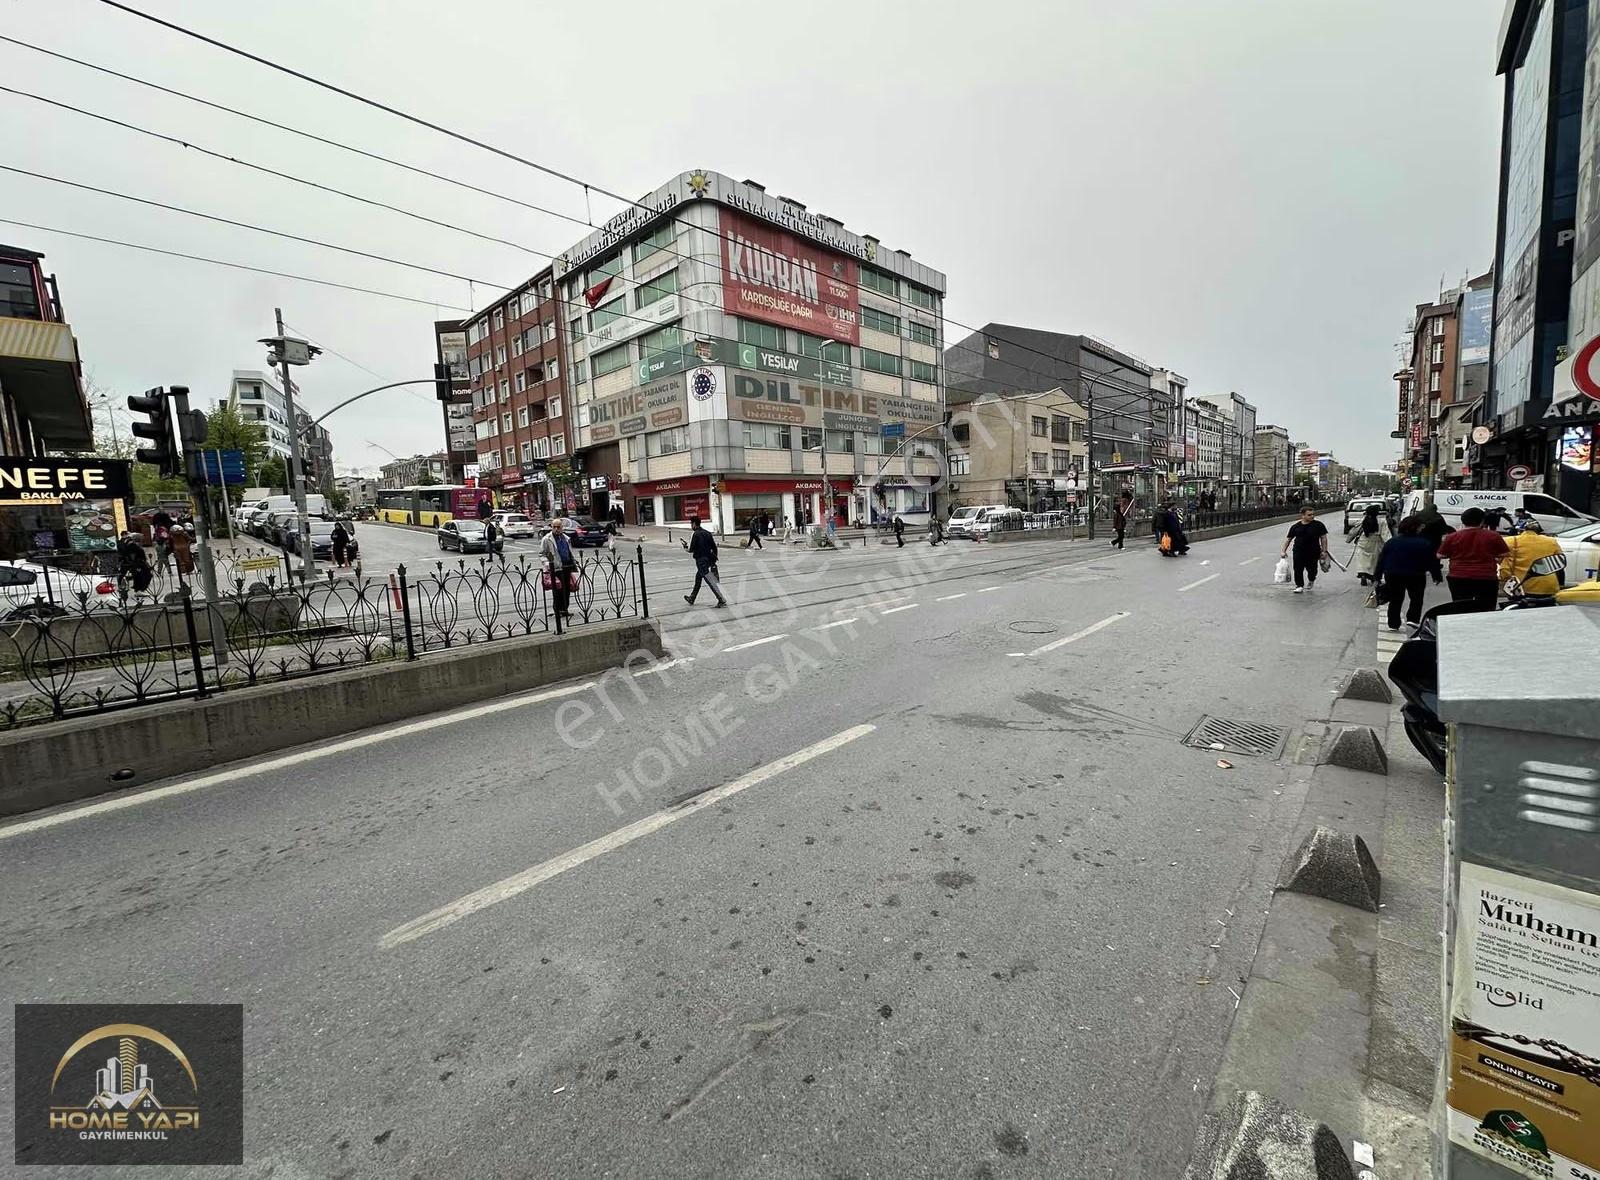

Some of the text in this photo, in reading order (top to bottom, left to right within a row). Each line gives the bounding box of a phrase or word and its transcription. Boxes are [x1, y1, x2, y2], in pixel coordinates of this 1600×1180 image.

[727, 230, 819, 305] KURBAN
[755, 403, 793, 414] GENEL
[887, 410, 933, 421] OKULLARI
[656, 482, 680, 491] AKBANK
[20, 491, 85, 500] BAKLAVA
[1480, 889, 1534, 911] Hazreti
